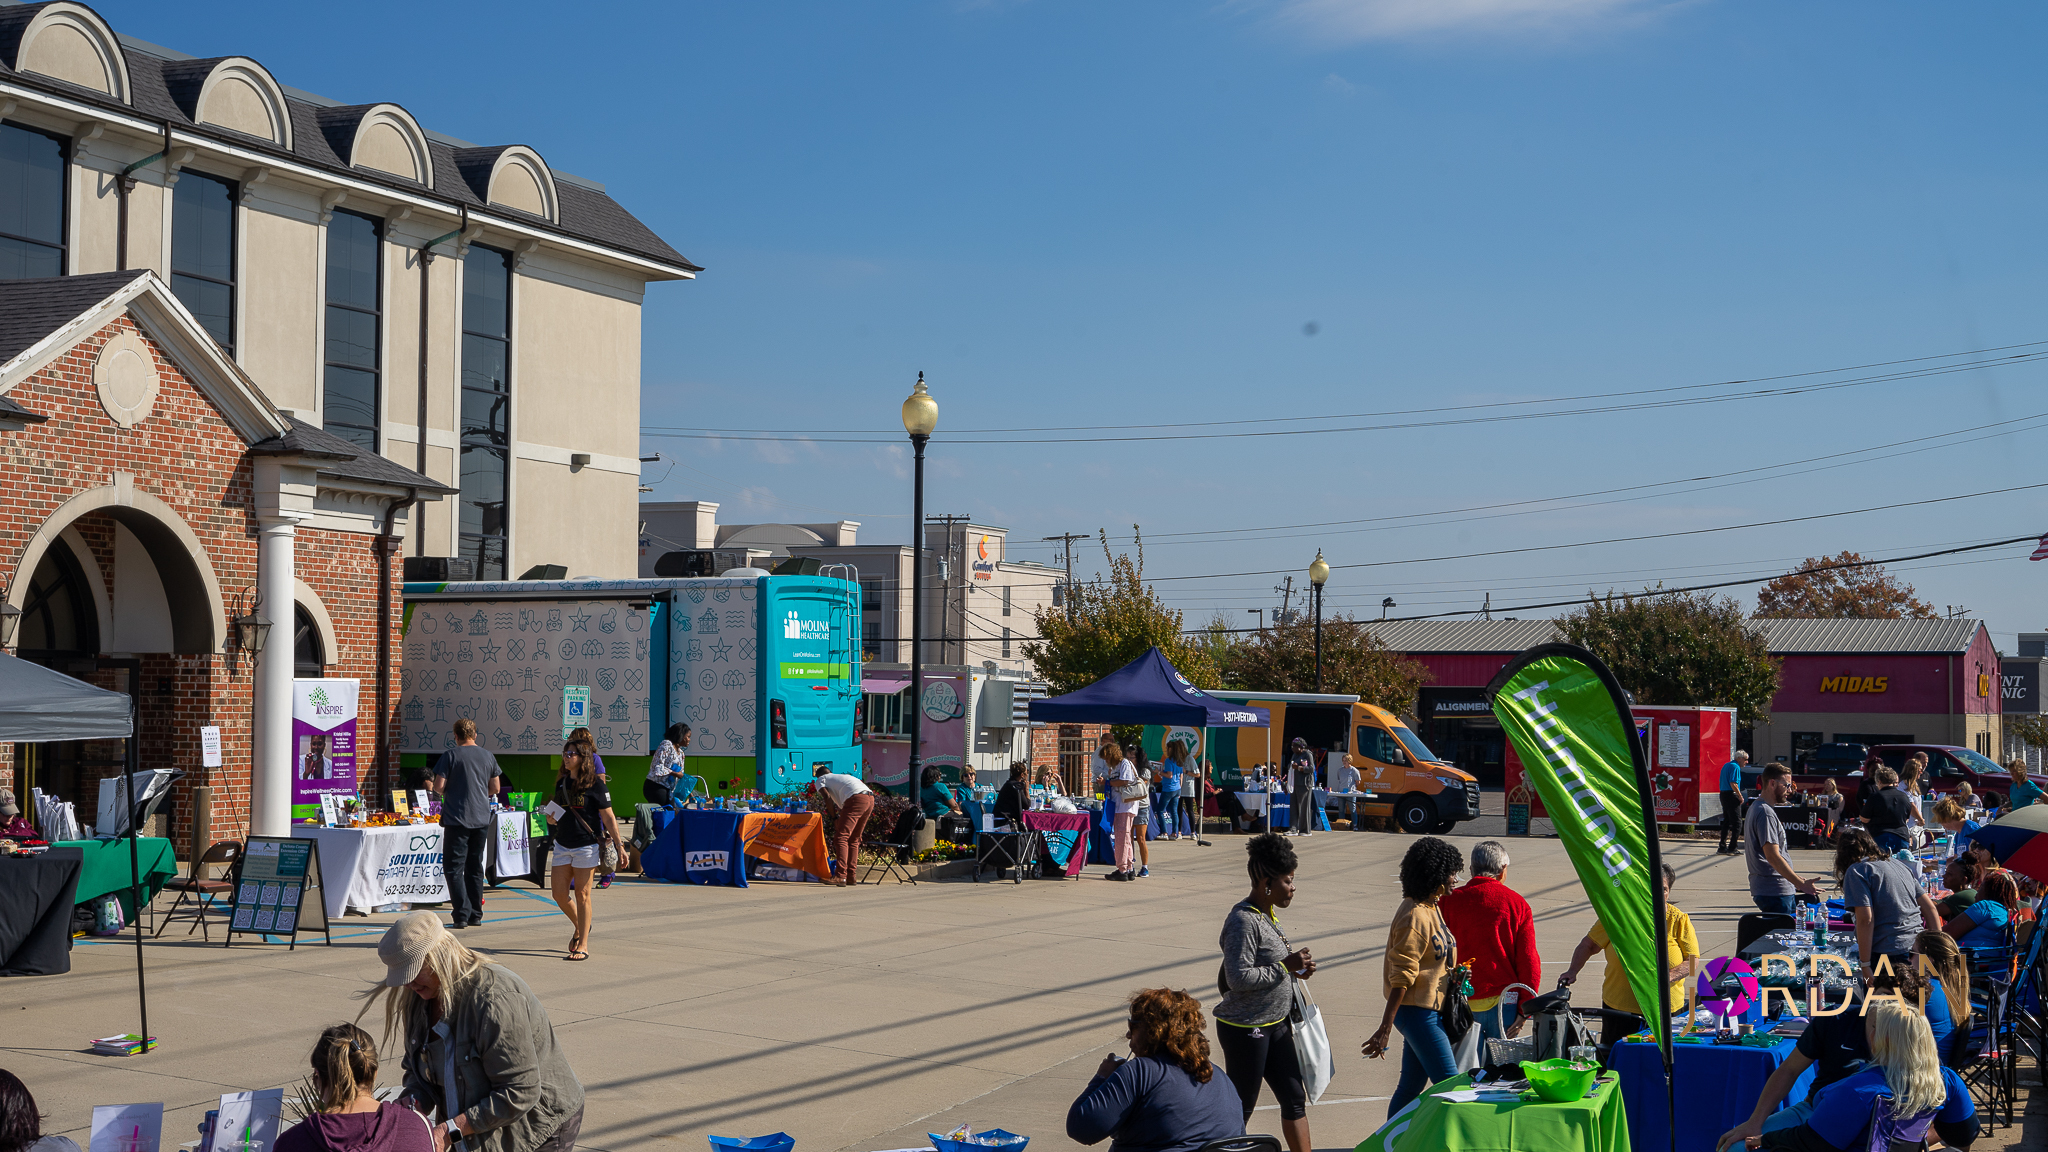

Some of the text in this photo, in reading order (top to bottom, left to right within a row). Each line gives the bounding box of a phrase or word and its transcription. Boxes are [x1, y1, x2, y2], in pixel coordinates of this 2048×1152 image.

[801, 620, 829, 632] MOLINA
[801, 632, 829, 640] HEALTHCARE
[1820, 676, 1888, 692] MIDAS
[316, 701, 343, 714] INSPIRE
[1435, 702, 1490, 711] ALIGNMEN
[926, 754, 961, 764] experience
[1513, 680, 1632, 877] Humana
[389, 853, 443, 867] SOUTHAVE
[690, 853, 724, 867] AEH
[412, 866, 431, 877] EYE
[433, 866, 444, 877] CA
